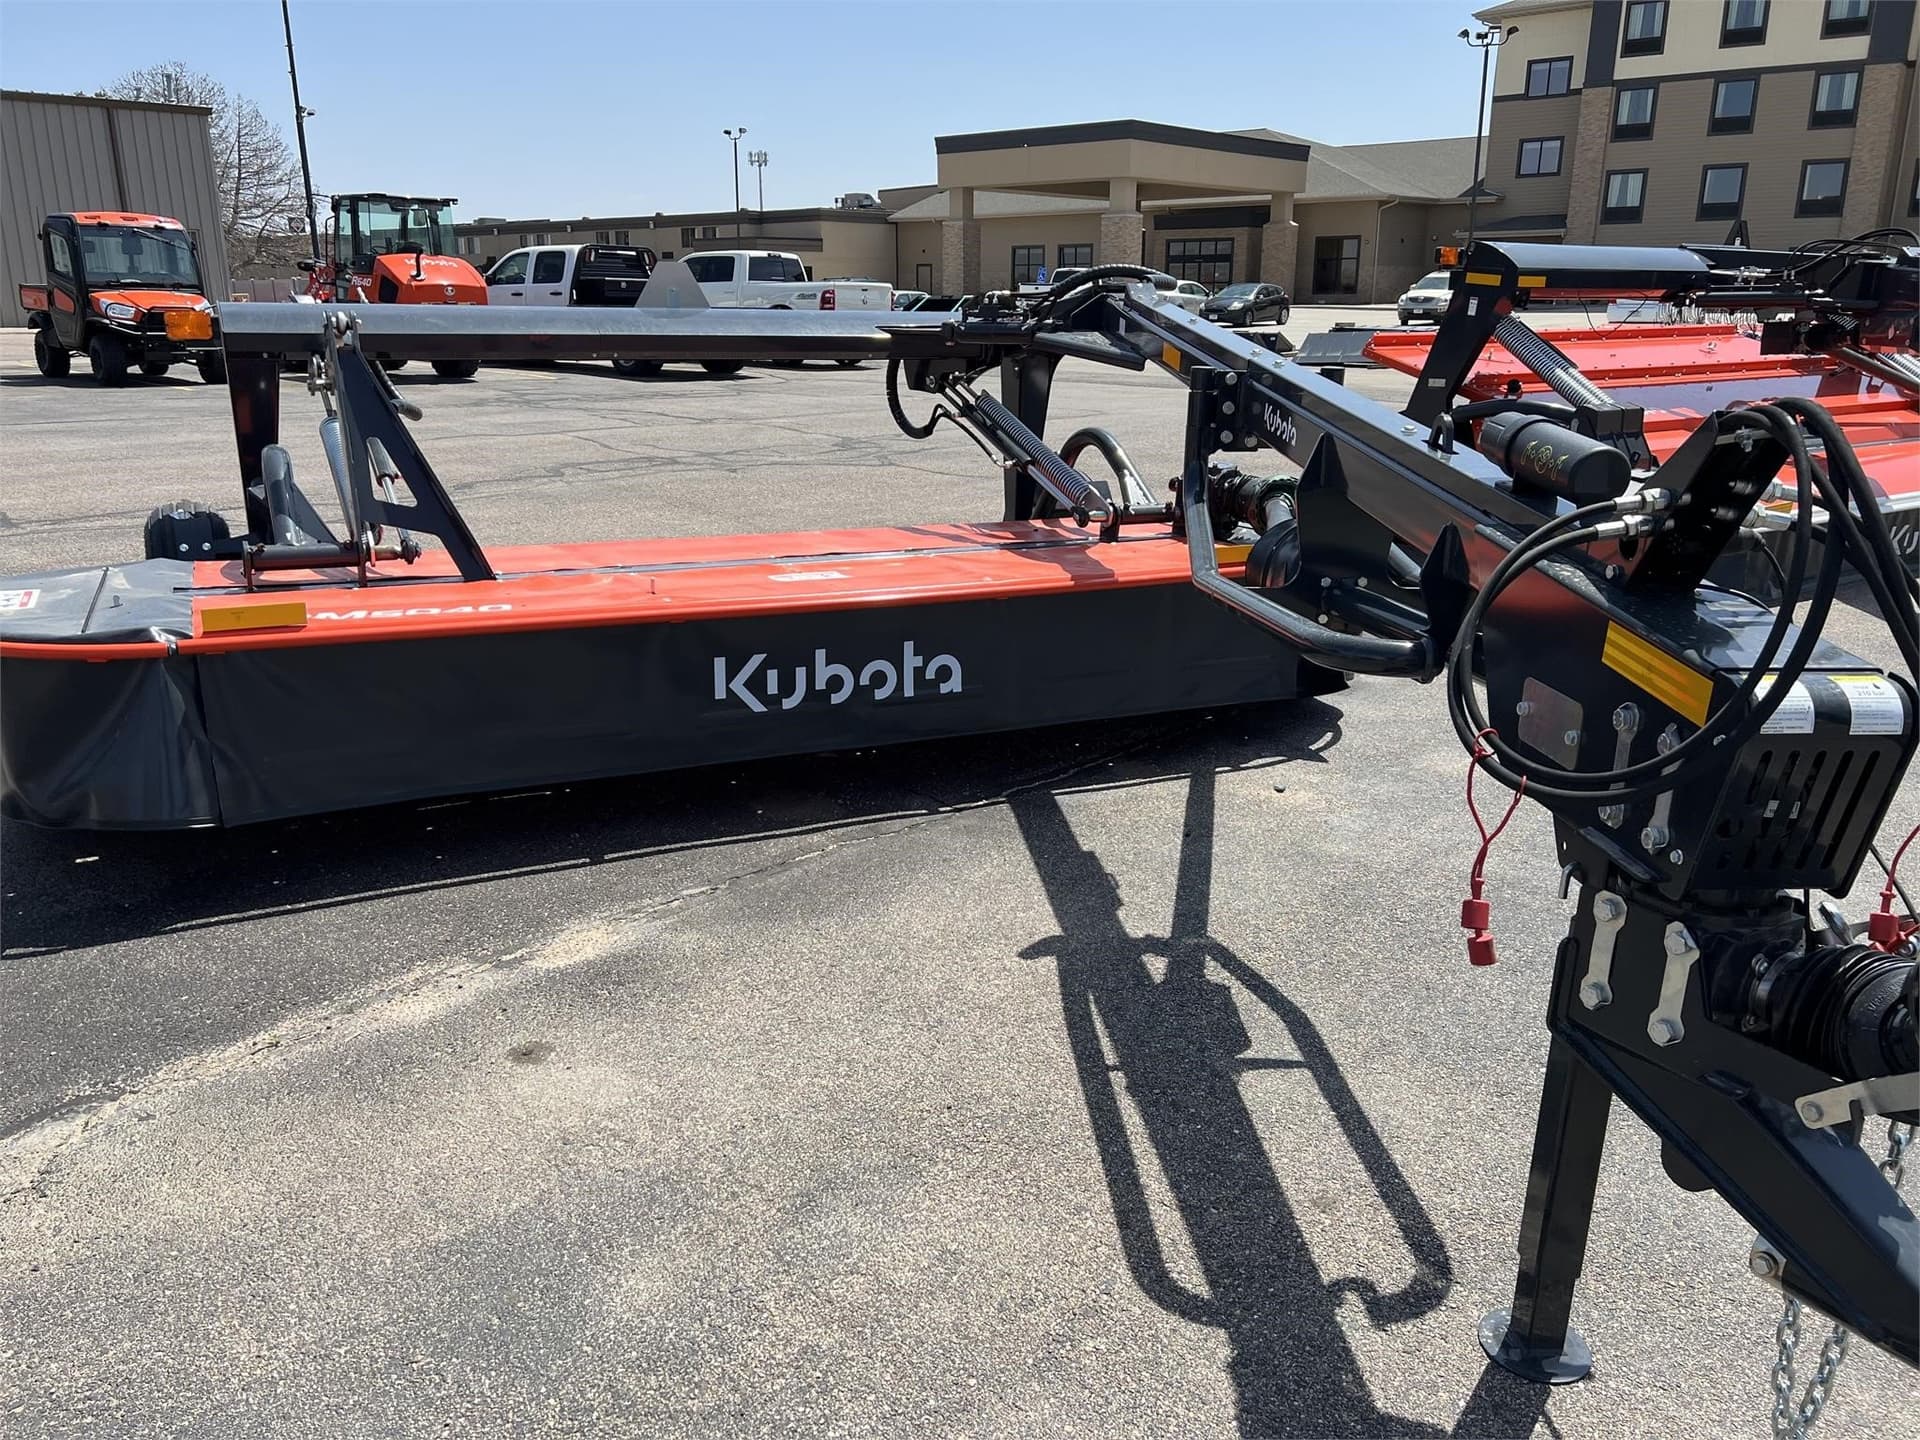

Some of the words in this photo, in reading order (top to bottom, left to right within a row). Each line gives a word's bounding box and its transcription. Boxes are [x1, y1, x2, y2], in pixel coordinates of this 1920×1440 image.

[1264, 402, 1297, 447] Kubota
[307, 604, 513, 620] M5040
[713, 640, 962, 712] Kubota
